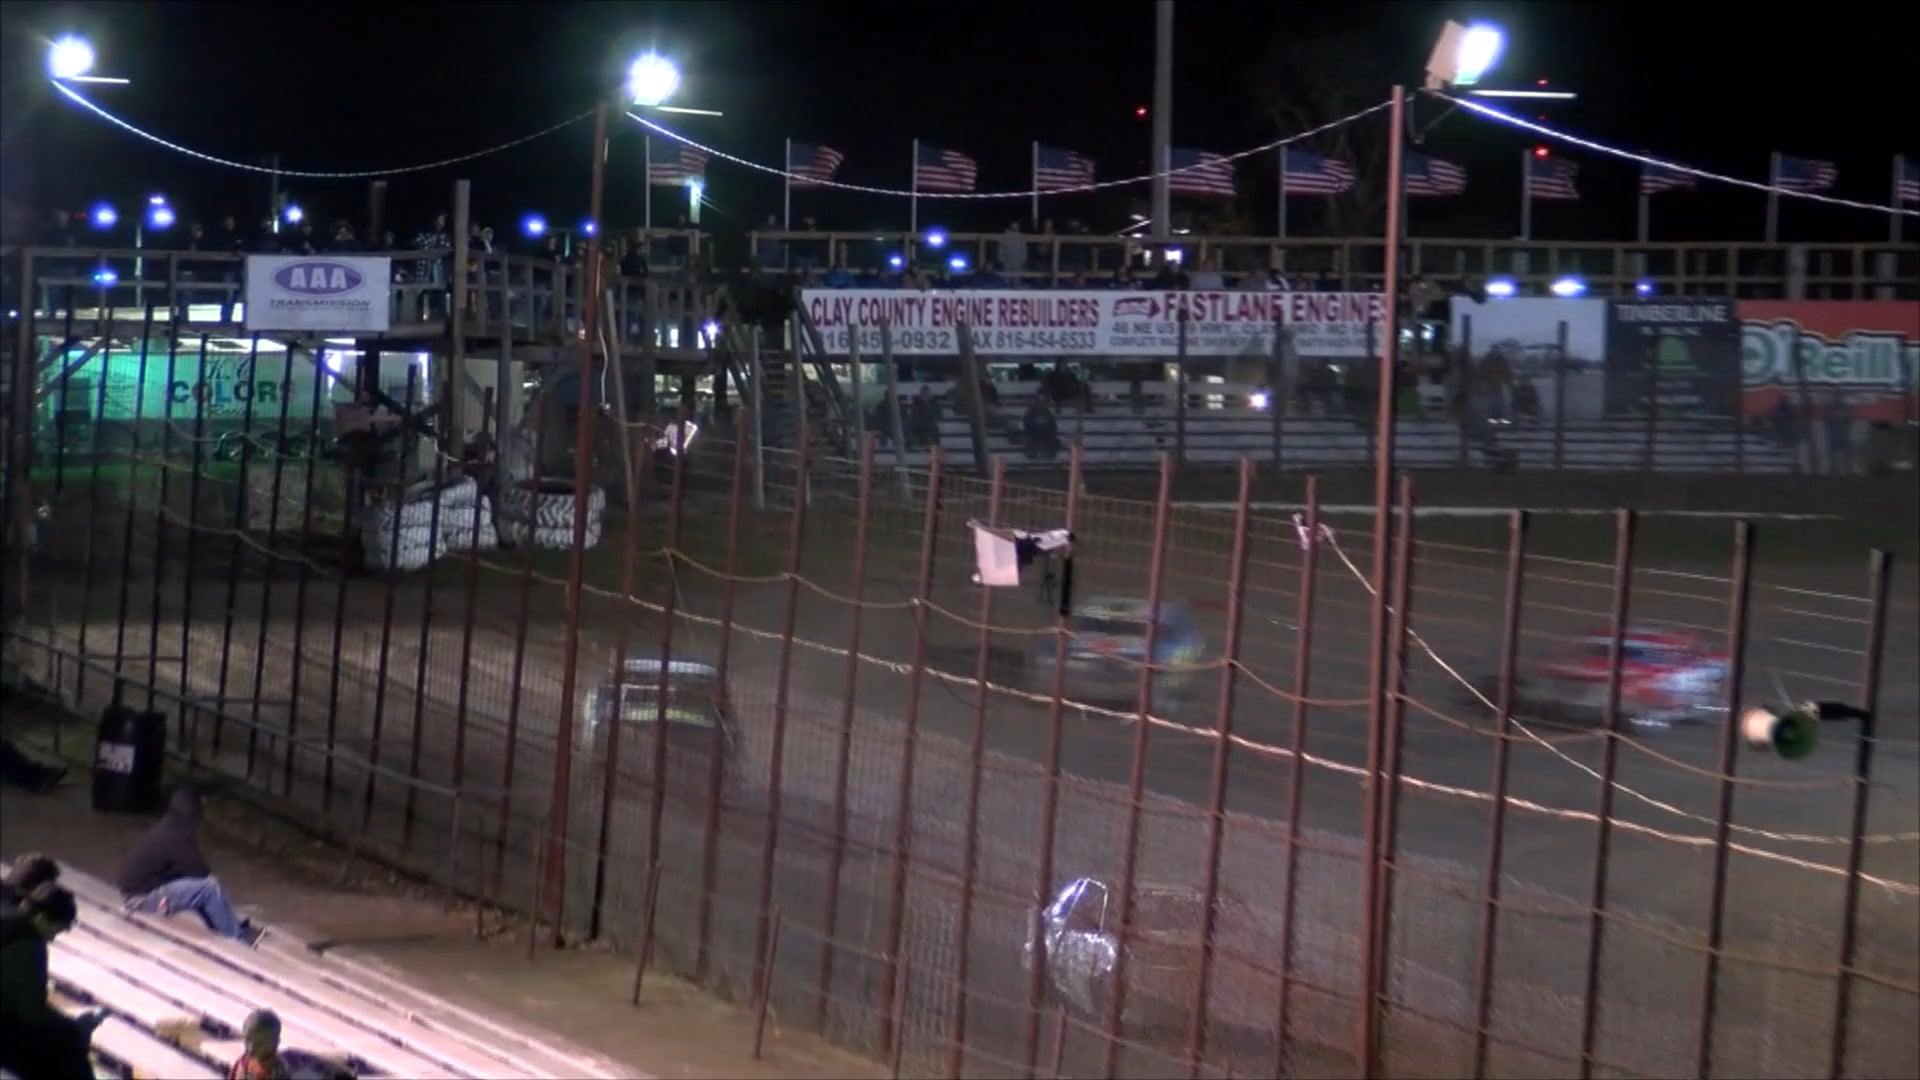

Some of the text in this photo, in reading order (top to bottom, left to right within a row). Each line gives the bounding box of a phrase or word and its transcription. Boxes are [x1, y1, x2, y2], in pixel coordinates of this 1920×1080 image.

[289, 267, 348, 289] AAA
[270, 299, 371, 308] TRANSMISSION
[811, 297, 853, 326] CLAY
[858, 297, 927, 326] COUNTY
[932, 297, 993, 327] ENGINE
[998, 298, 1100, 327] REBUILDERS
[1163, 292, 1283, 322] FASTLANE
[1293, 293, 1386, 323] ENGINE
[1616, 304, 1730, 322] TIMBERLINE
[996, 331, 1097, 349] 816-454-6533
